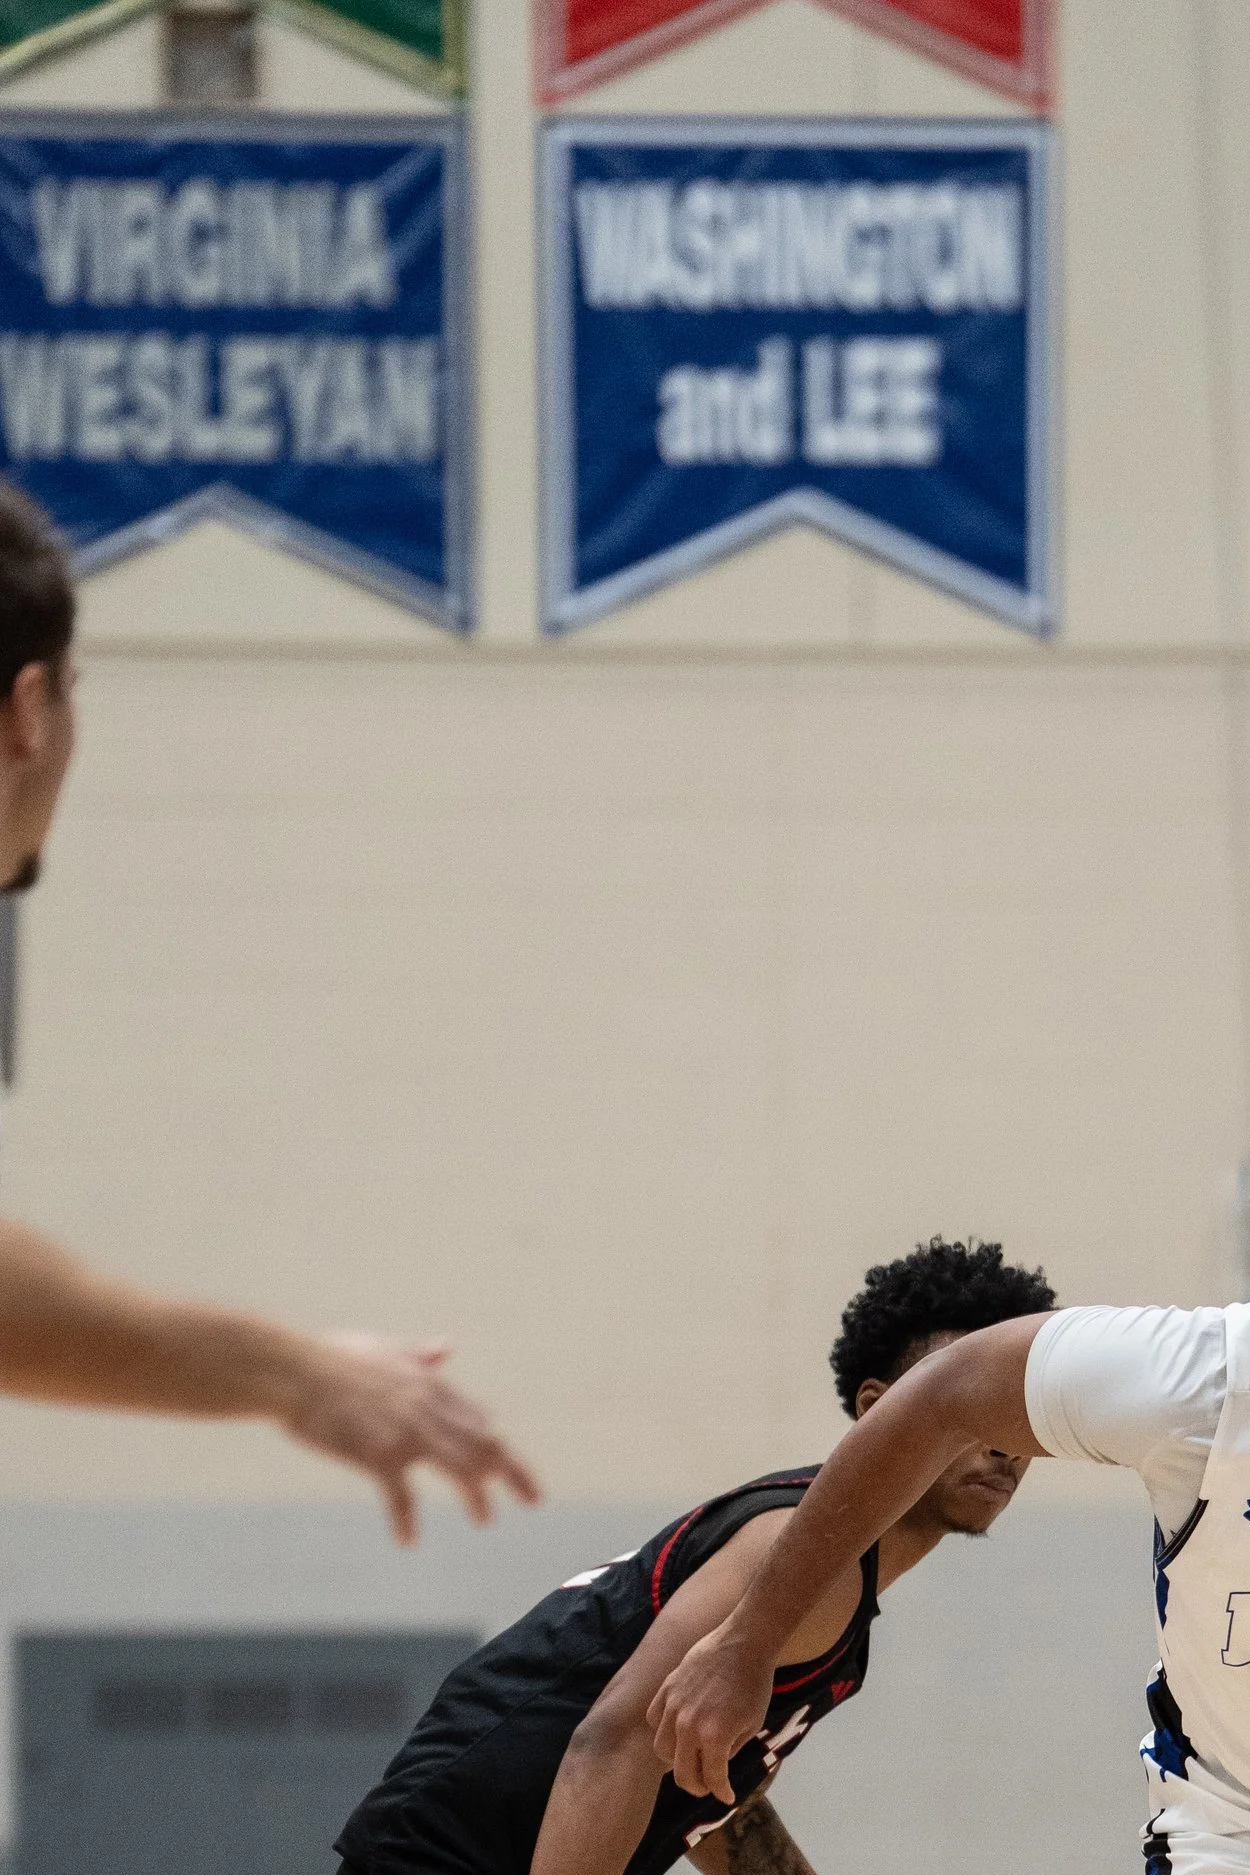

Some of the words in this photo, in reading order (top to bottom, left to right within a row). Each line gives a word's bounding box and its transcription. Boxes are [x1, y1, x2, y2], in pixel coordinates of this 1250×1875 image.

[32, 175, 396, 308] VIRGINIA
[573, 178, 1024, 314] WASHINGTON
[0, 329, 440, 464] WESLEYAN
[656, 333, 797, 468] and
[801, 333, 945, 468] LEE
